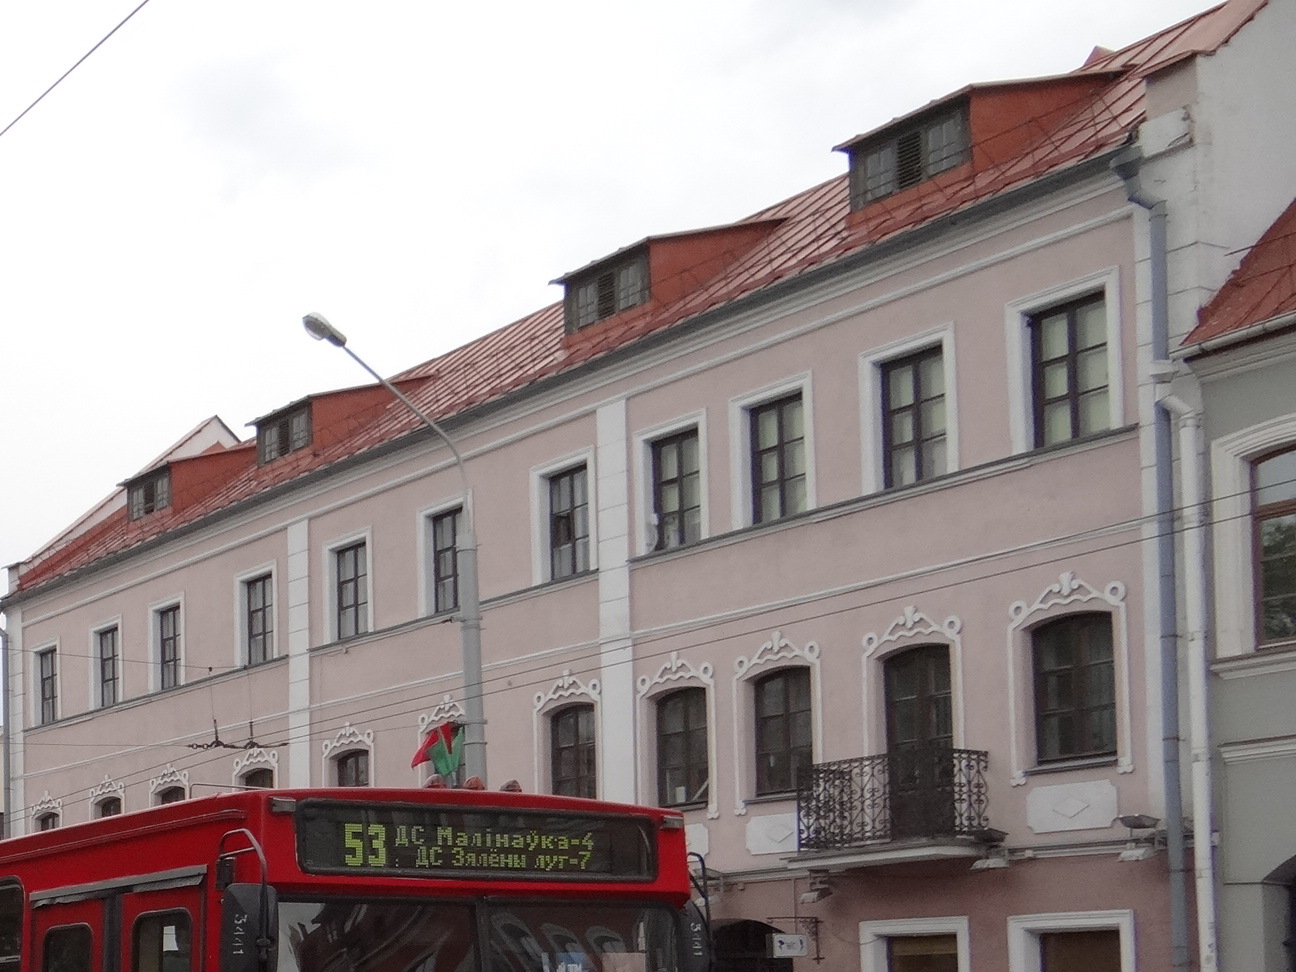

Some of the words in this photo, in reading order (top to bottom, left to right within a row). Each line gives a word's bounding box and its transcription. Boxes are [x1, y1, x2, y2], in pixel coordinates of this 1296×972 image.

[344, 823, 387, 867] 53
[395, 825, 425, 847] ДС
[415, 846, 443, 868] ДС
